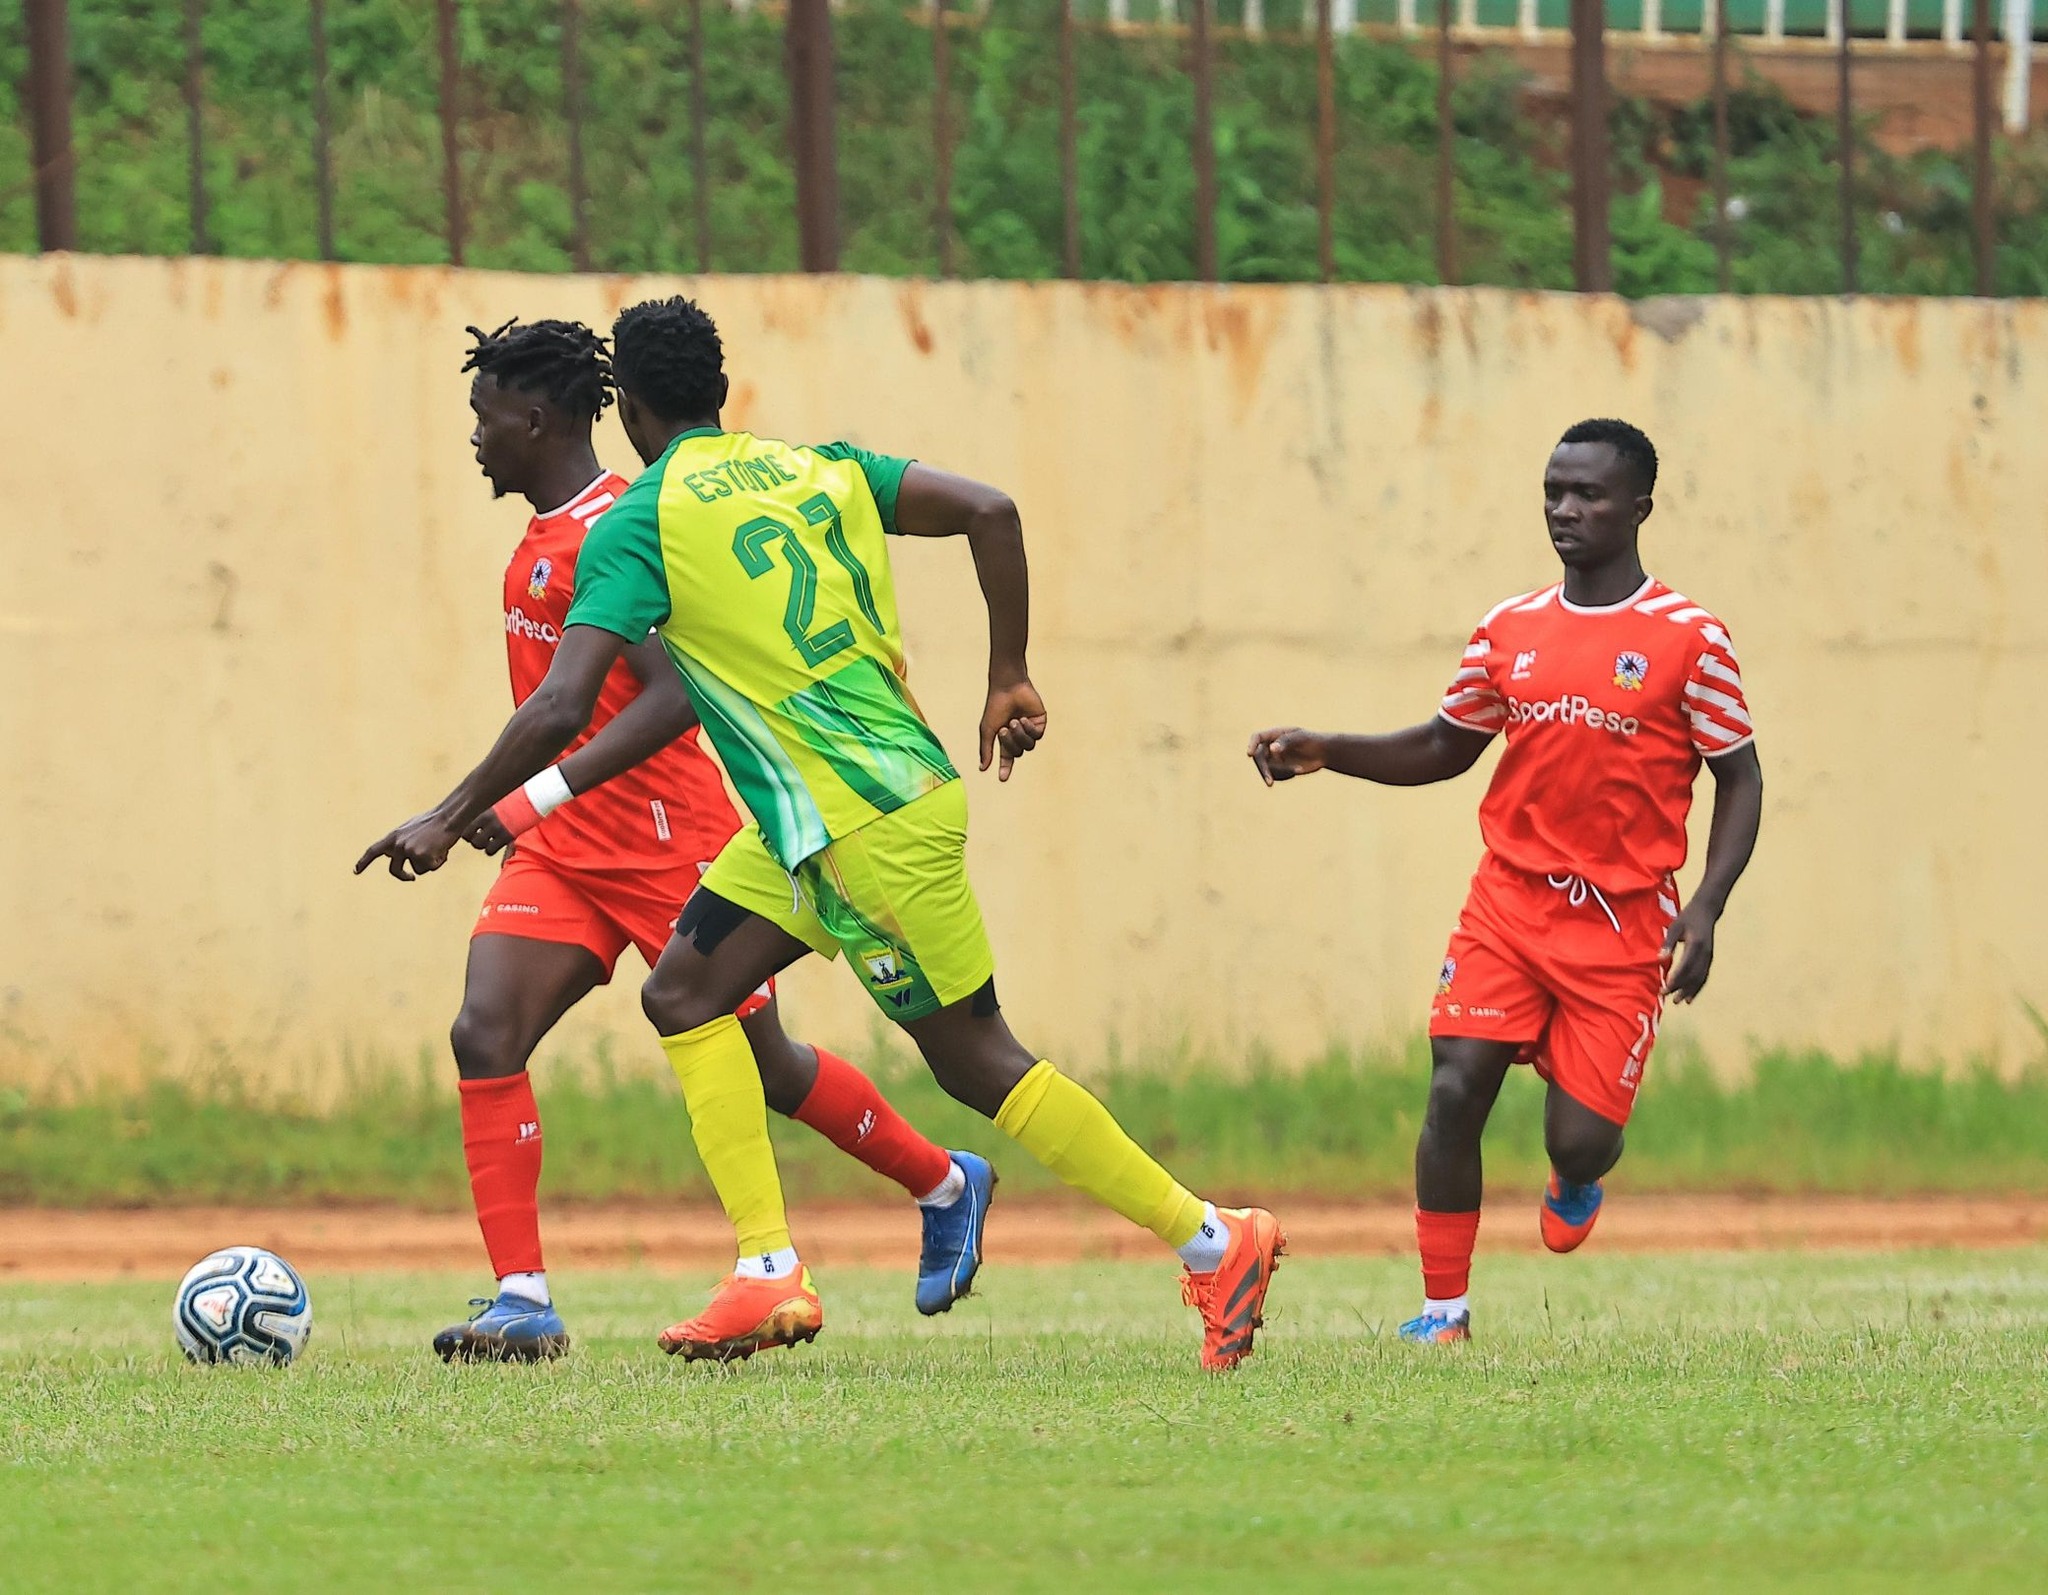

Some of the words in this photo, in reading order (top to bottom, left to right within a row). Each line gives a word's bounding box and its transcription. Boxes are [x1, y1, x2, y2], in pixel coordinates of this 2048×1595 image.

[732, 492, 888, 670] 27
[1507, 694, 1640, 736] SportPesa
[496, 903, 540, 915] CASINO
